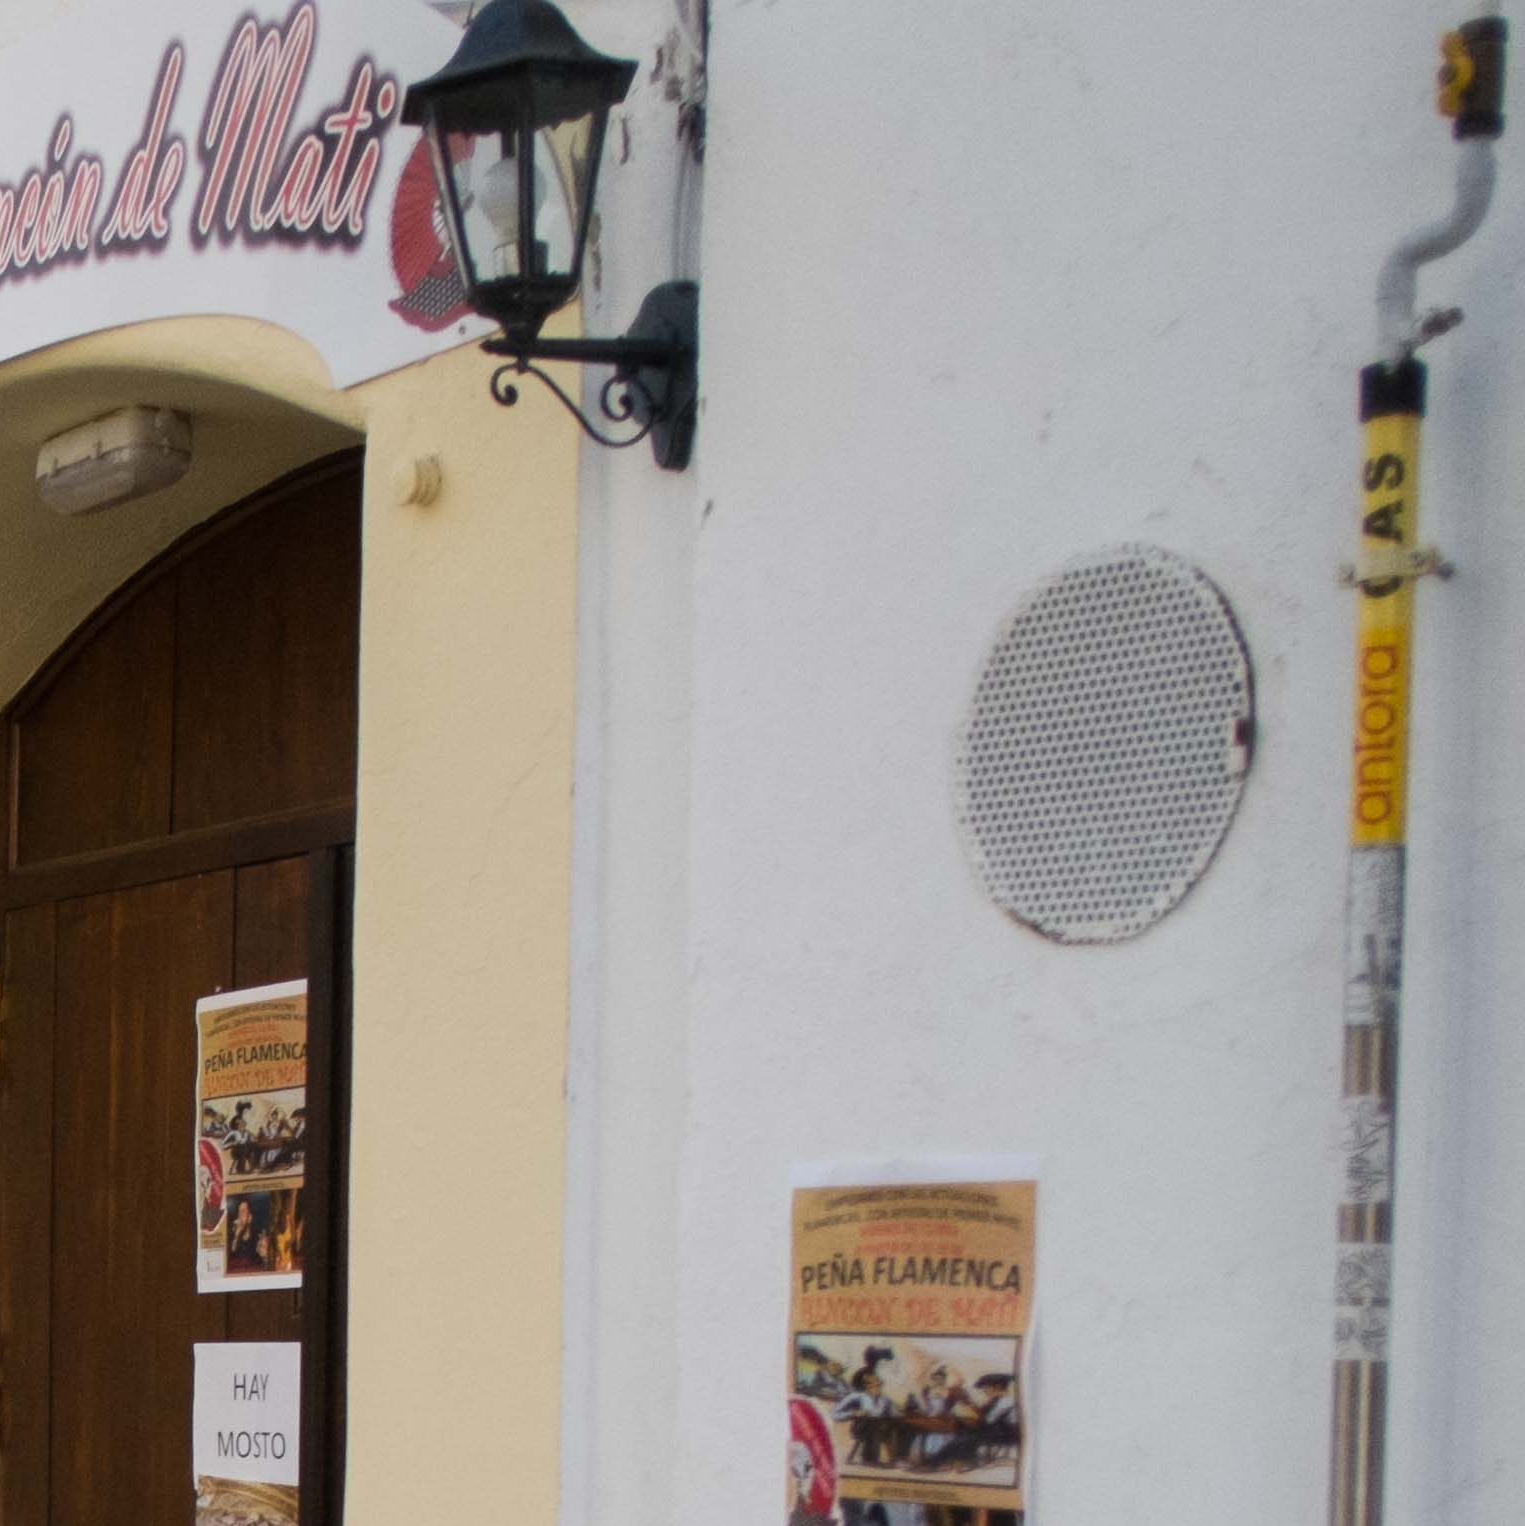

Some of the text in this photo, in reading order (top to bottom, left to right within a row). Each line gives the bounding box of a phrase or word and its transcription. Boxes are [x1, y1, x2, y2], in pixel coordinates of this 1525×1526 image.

[96, 40, 186, 260] de
[192, 0, 398, 252] Mati
[800, 1252, 1022, 1295] PEÑA FLAMENCA
[233, 1373, 269, 1401] HAY
[217, 1430, 286, 1459] MOSTO
